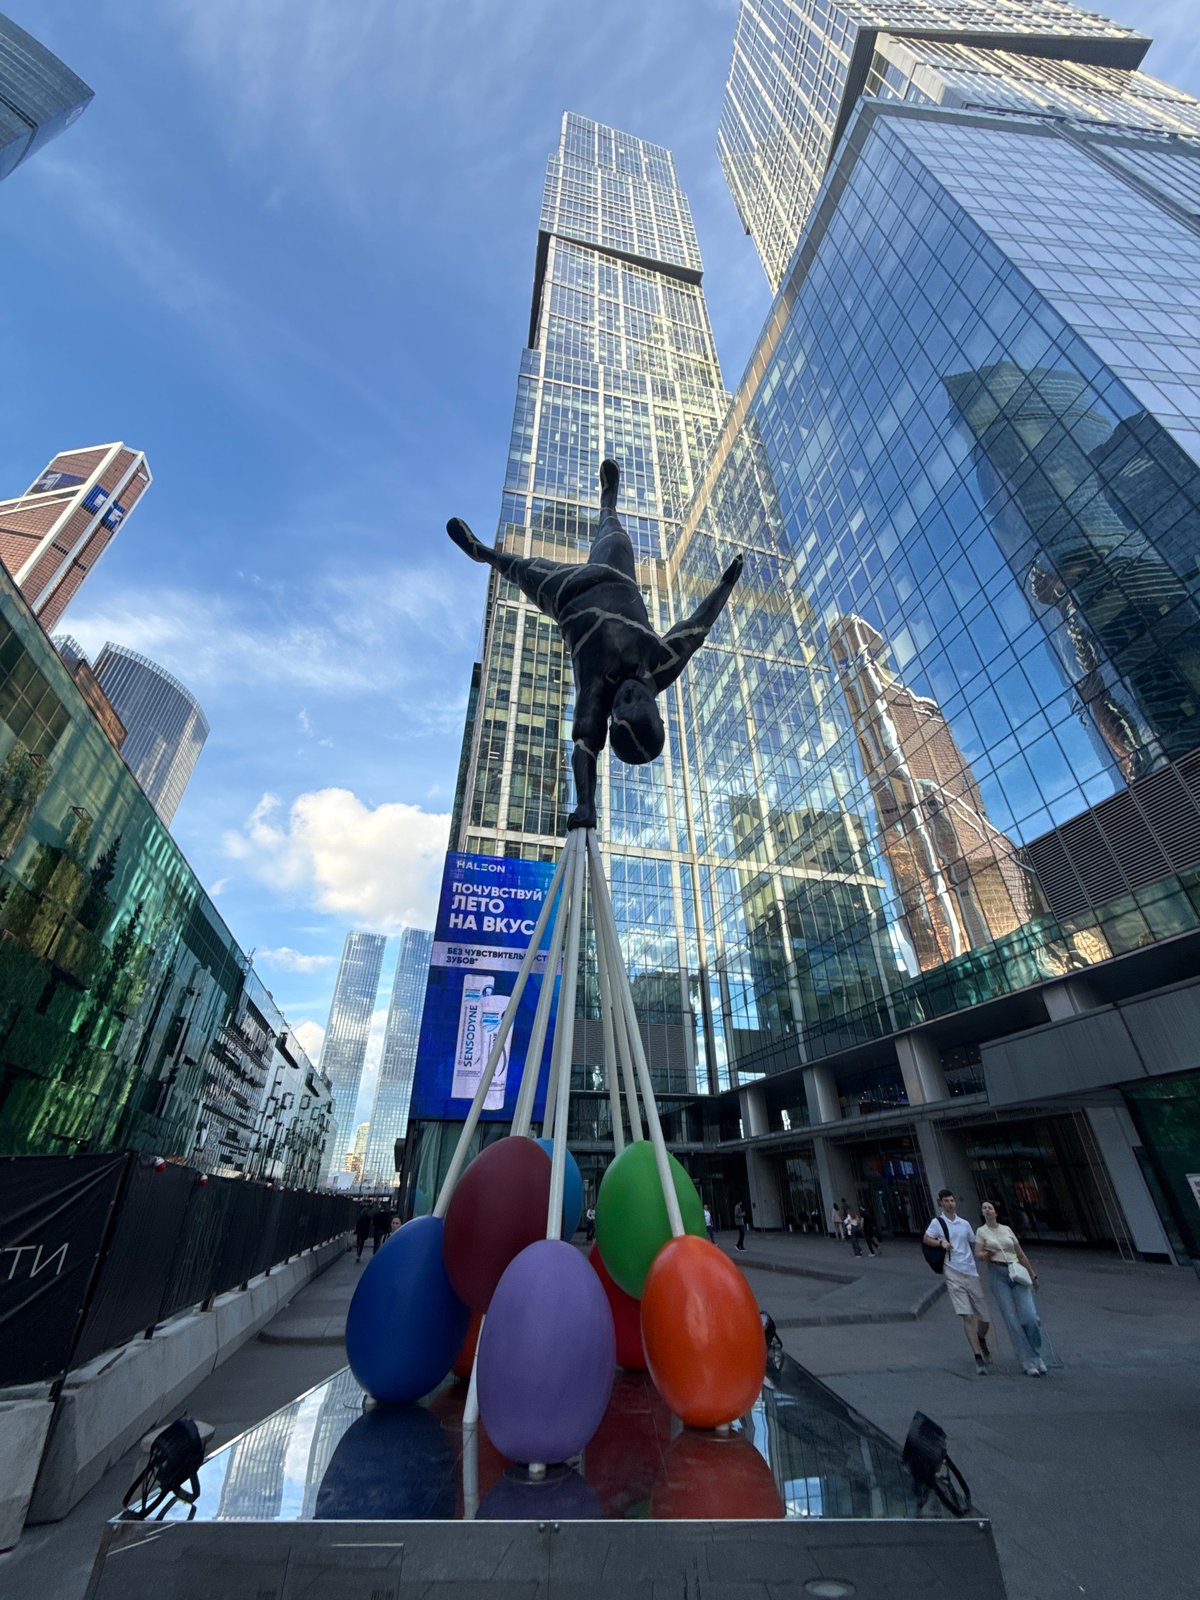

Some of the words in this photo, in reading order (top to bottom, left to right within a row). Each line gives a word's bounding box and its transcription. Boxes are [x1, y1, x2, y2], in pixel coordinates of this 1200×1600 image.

[456, 861, 506, 873] HALEON
[452, 882, 542, 901] ПОЧУВСТВУЙ
[451, 895, 505, 914] ЛЕТО
[449, 913, 478, 931] НА
[483, 916, 538, 935] ВКУС
[447, 947, 463, 955] БЕЗ
[464, 1005, 478, 1067] SENSODYNE
[0, 1243, 69, 1280] ТИ
